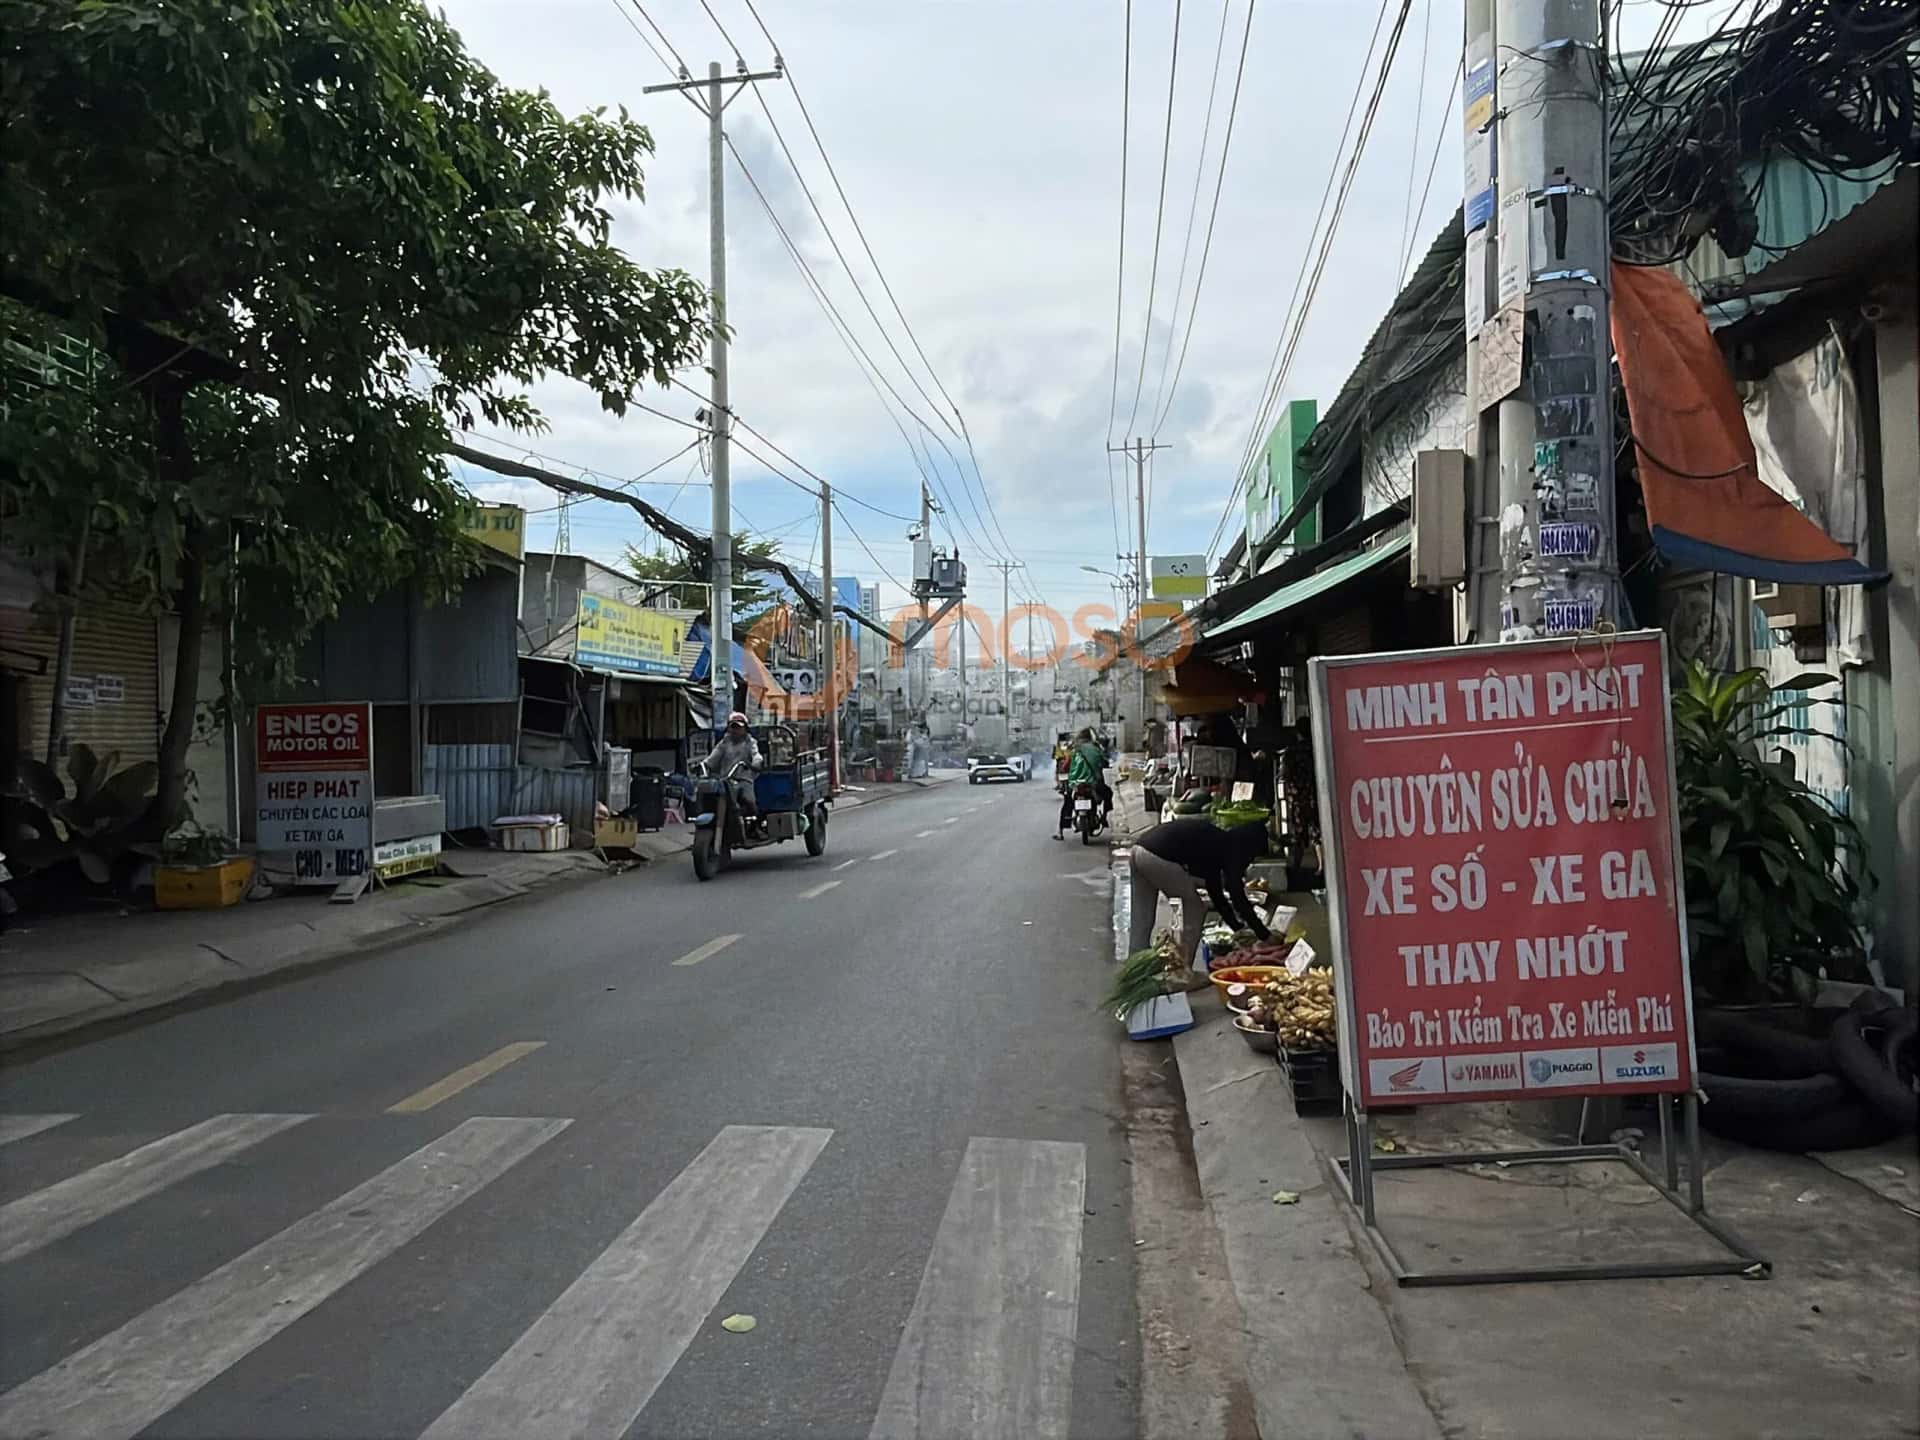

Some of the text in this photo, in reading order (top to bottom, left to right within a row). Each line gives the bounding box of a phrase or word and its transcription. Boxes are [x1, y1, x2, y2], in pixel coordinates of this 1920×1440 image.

[266, 713, 359, 736] ENEOS
[1346, 681, 1445, 731] MINH
[1458, 667, 1535, 722] TÂN
[267, 737, 360, 752] MOTOR OIL
[1350, 741, 1656, 839] CHUYÊN SỬA CHỮA
[303, 830, 322, 842] TAY
[327, 829, 344, 842] GA
[1361, 843, 1656, 916] XE SỐ - XE GA
[1398, 926, 1628, 987] THAY NHỚT
[1366, 989, 1674, 1049] Bảo Trì Kiểm Tra Xe Miễn Phí
[1464, 1062, 1666, 1081] YAMAHA PIAGGIO SUZUKI
